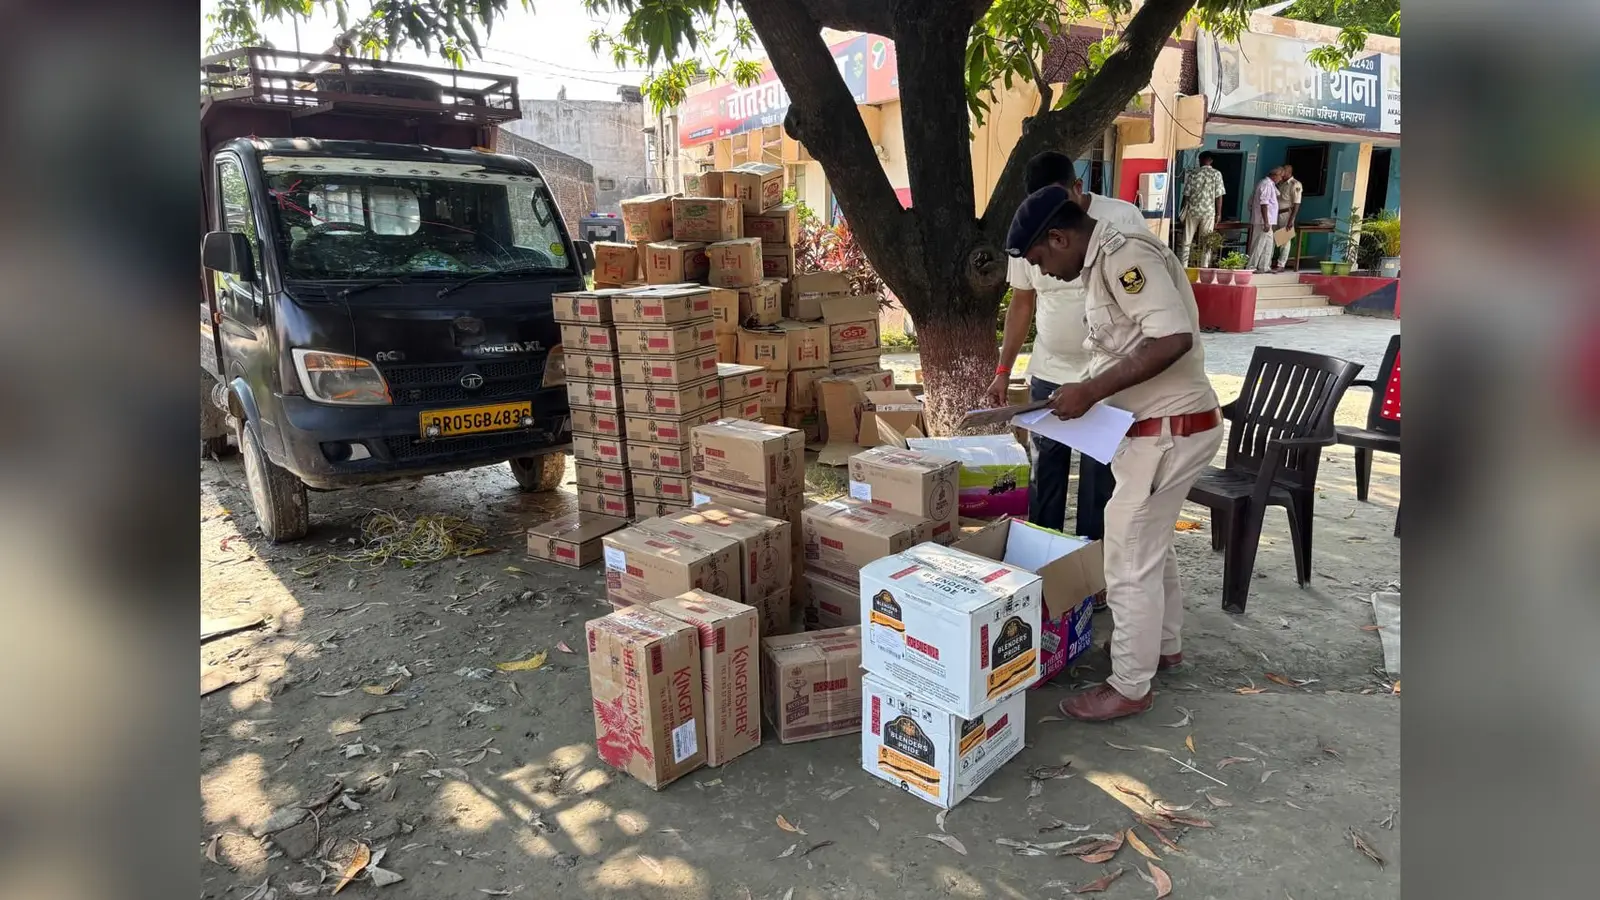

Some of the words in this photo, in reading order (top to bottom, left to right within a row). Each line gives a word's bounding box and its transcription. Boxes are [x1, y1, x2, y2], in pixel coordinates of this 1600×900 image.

[1329, 69, 1378, 108] थाना
[843, 328, 864, 338] GST
[923, 572, 978, 595] BLENDERS
[925, 581, 959, 596] PRIDE
[997, 632, 1028, 655] BLENDERS
[1003, 645, 1021, 659] PRIDE
[1069, 641, 1078, 660] 21
[672, 665, 693, 723] KINGFI
[733, 645, 749, 739] KINGFISHER
[890, 731, 928, 752] BLENDERS
[898, 741, 920, 756] PRIDE
